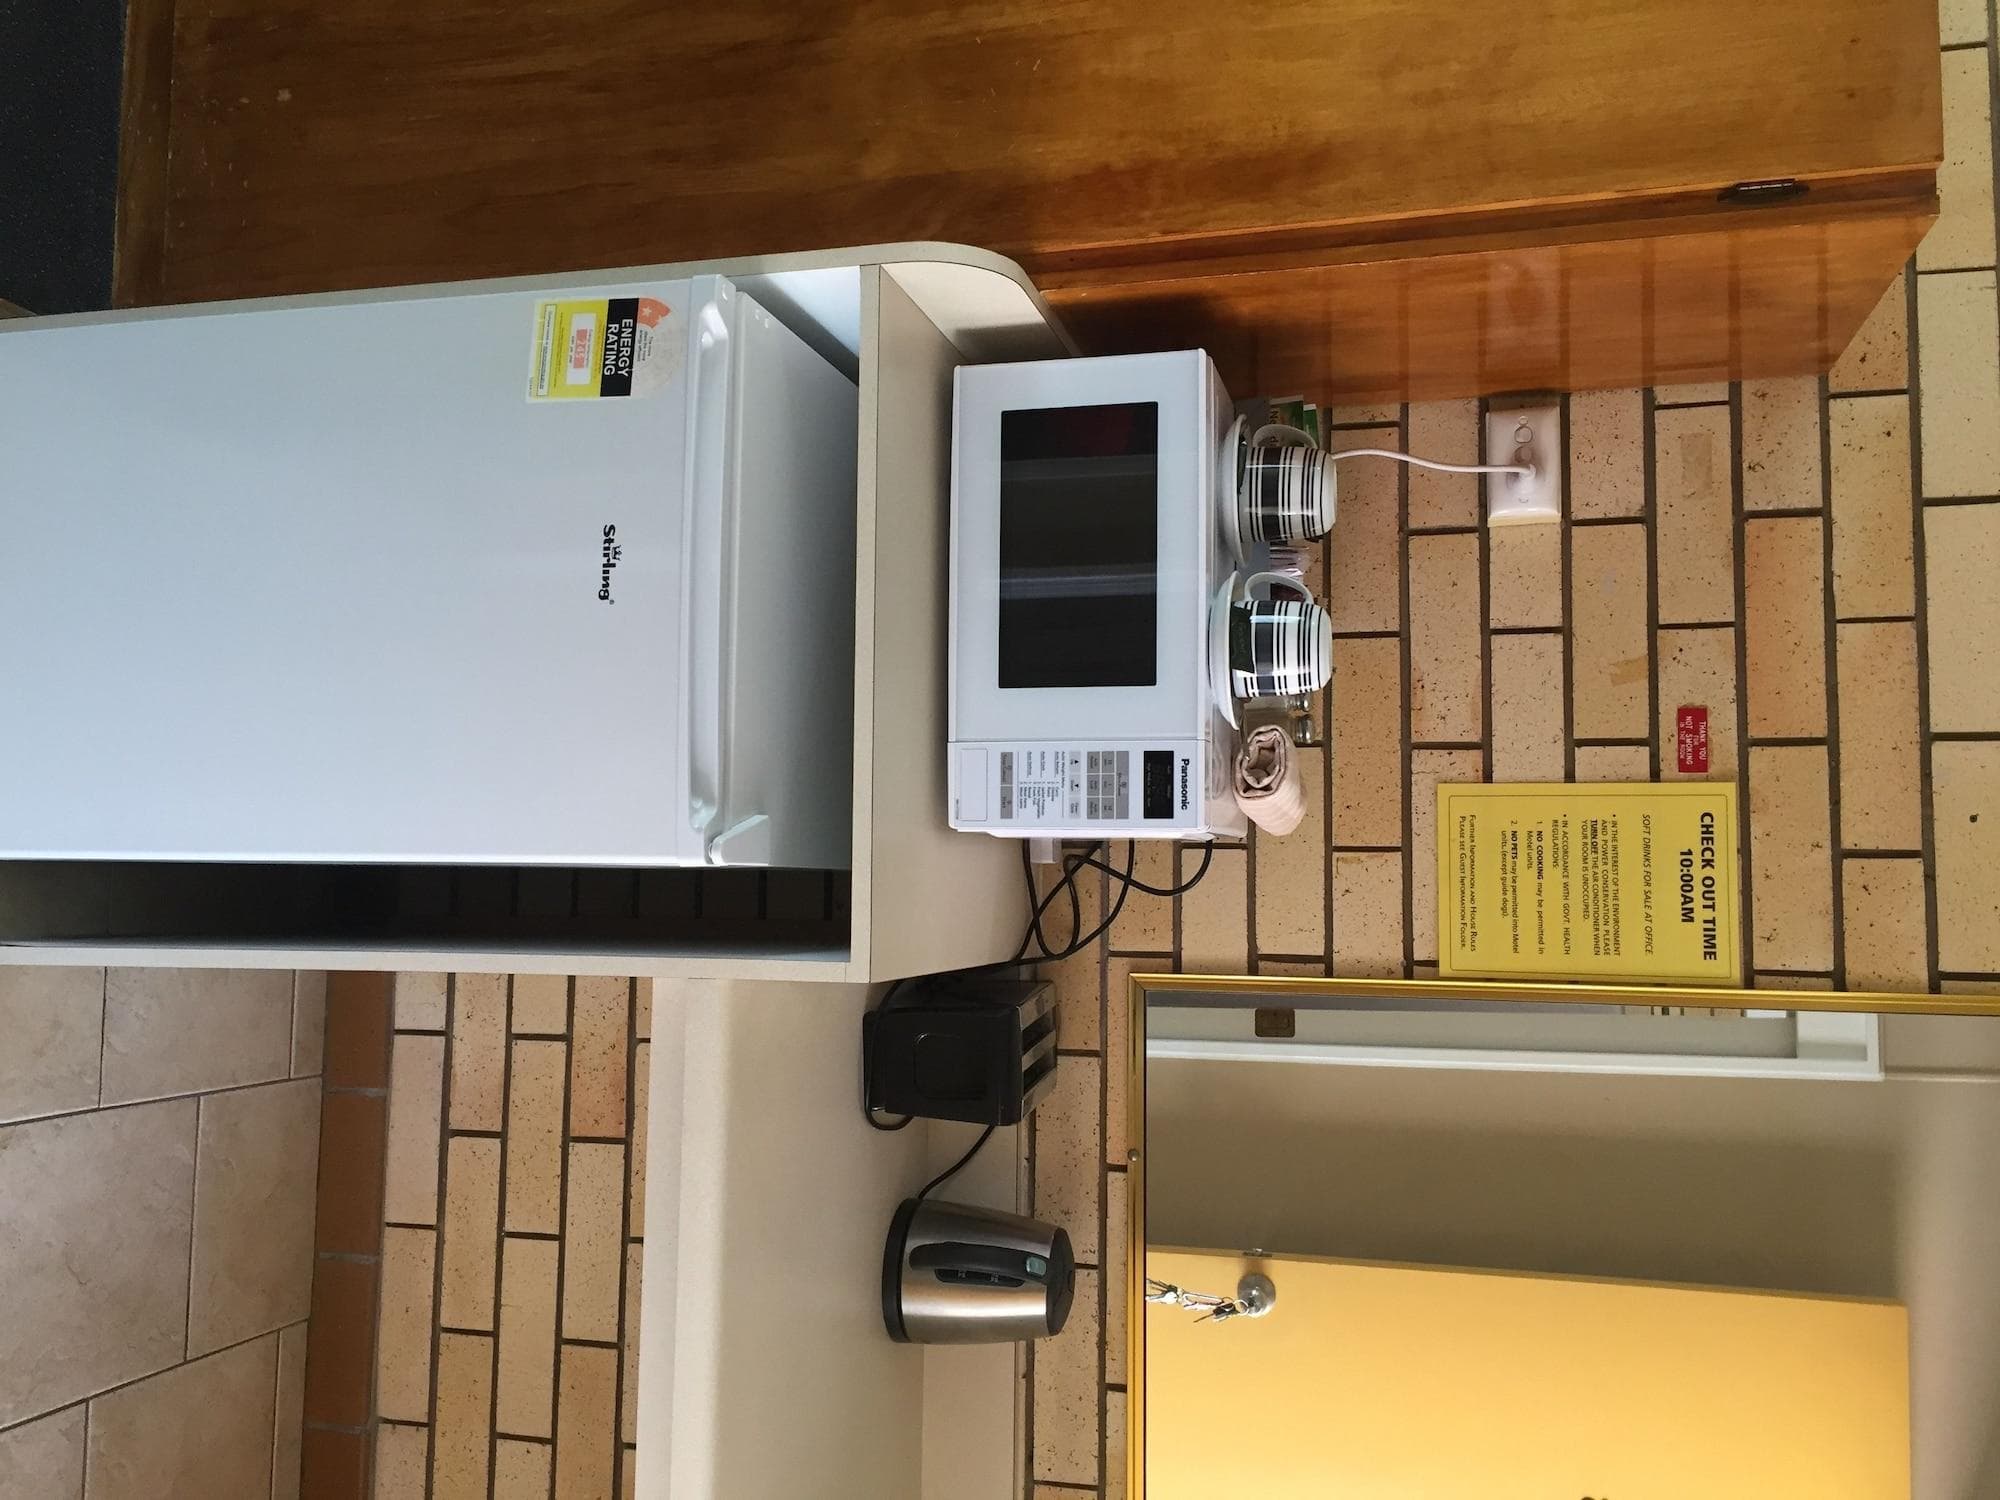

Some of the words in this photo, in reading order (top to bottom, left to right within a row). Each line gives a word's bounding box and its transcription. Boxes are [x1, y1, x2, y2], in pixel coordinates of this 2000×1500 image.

[604, 324, 619, 375] RATING
[617, 319, 633, 376] ENERGY
[598, 524, 616, 600] Stirling
[1181, 758, 1190, 810] Panasonic
[1511, 831, 1517, 841] NO
[1537, 831, 1543, 842] NO
[1562, 820, 1568, 828] IN
[1643, 814, 1651, 835] SOFT
[1643, 838, 1651, 868] DRINKS
[1701, 812, 1714, 869] CHECK
[1500, 851, 1508, 876] (except
[1500, 877, 1508, 896] guide
[1512, 876, 1518, 884] be
[1612, 878, 1619, 887] OF
[1644, 870, 1652, 887] FOR
[1680, 849, 1694, 922] 10:00AM
[1537, 900, 1544, 908] be
[1582, 874, 1590, 921] UNOCCUPIED.
[1602, 870, 1610, 926] CONSERVATION
[1644, 890, 1652, 910] SALE
[1702, 876, 1715, 912] OUT
[1500, 898, 1509, 918] dogs).
[1592, 884, 1600, 932] CONDITIONER
[1645, 912, 1652, 923] AT
[1536, 910, 1544, 944] permitted
[1703, 917, 1716, 960] TIME
